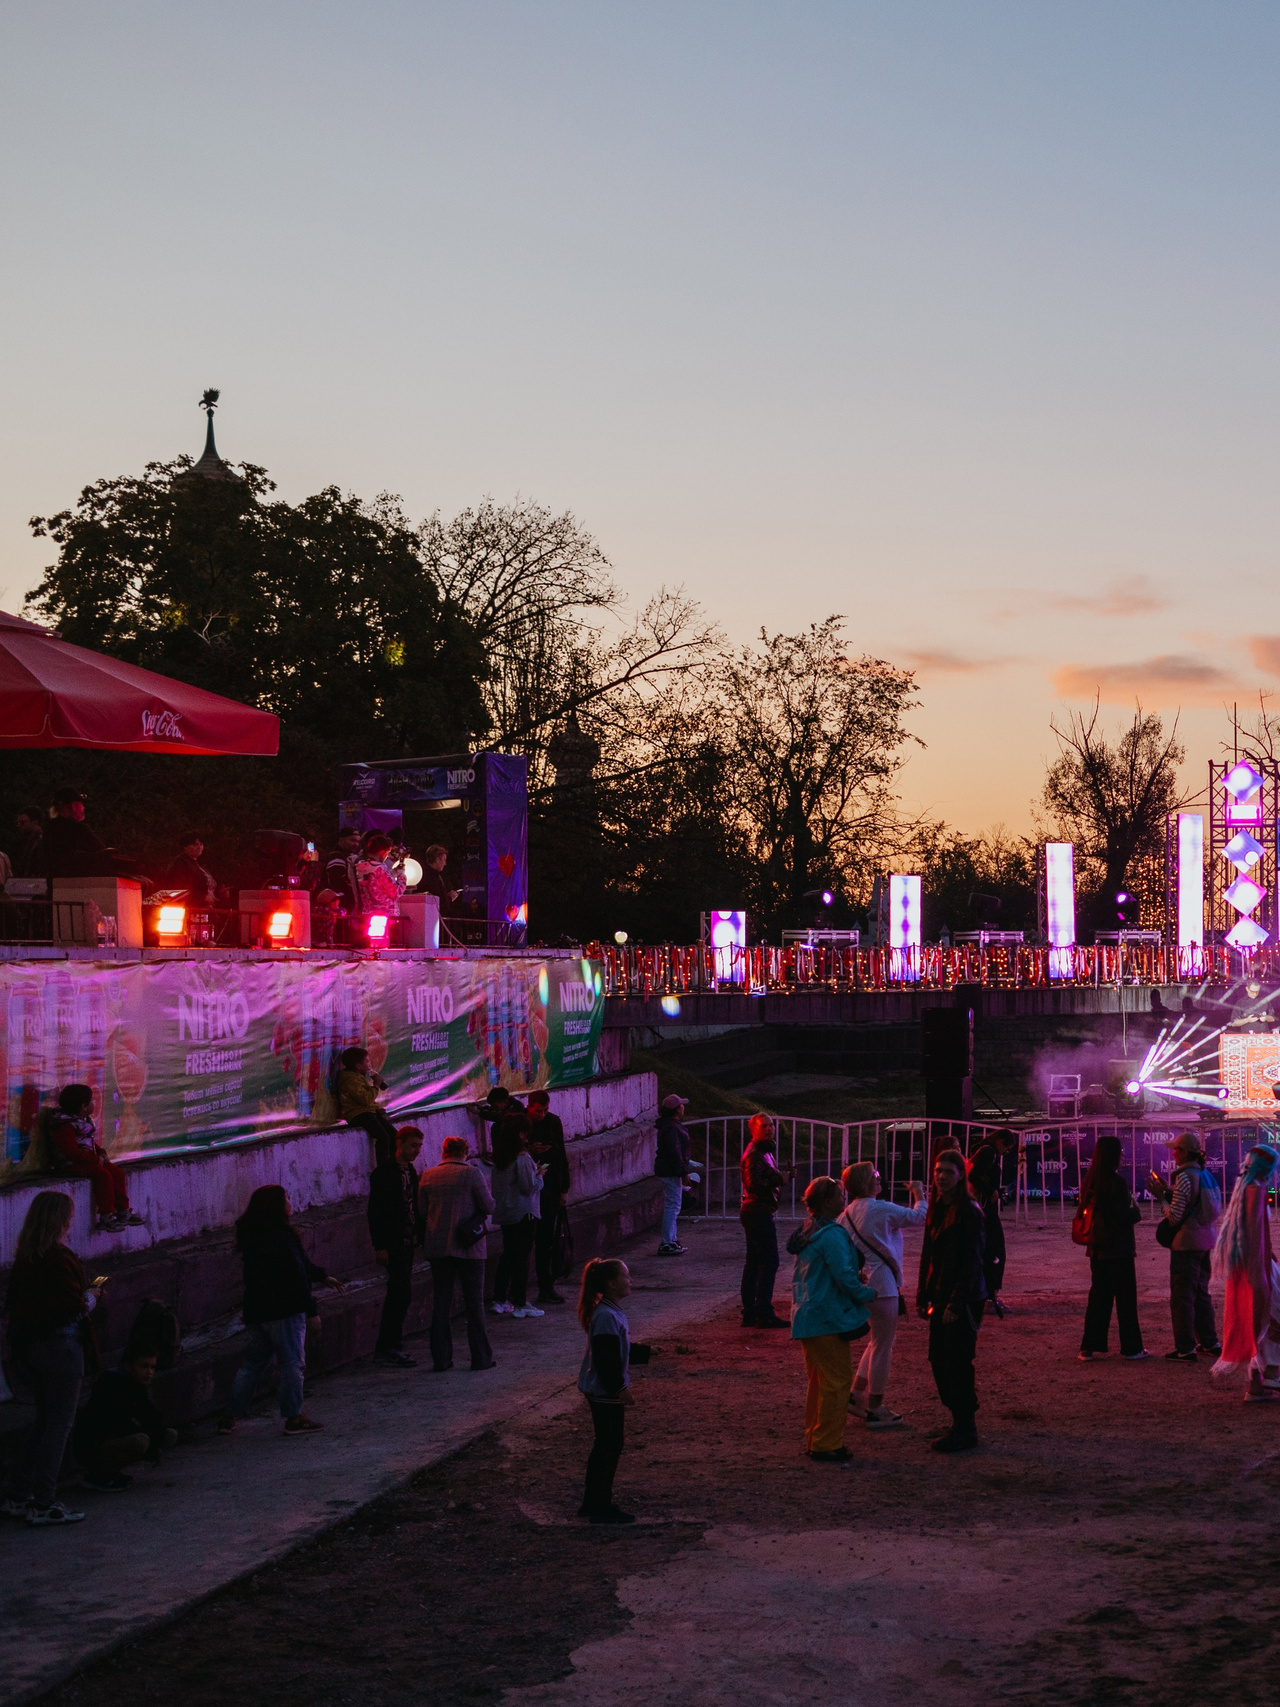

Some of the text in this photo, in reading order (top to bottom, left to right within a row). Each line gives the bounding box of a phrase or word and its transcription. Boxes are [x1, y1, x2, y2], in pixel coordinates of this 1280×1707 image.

[447, 768, 476, 784] NITRO
[560, 981, 596, 1012] NITRO
[407, 986, 454, 1025] NITRO
[178, 992, 250, 1041] NITRO
[225, 1050, 243, 1061] SOFT
[1143, 1131, 1176, 1141] NITRO
[1036, 1160, 1068, 1170] NITRO
